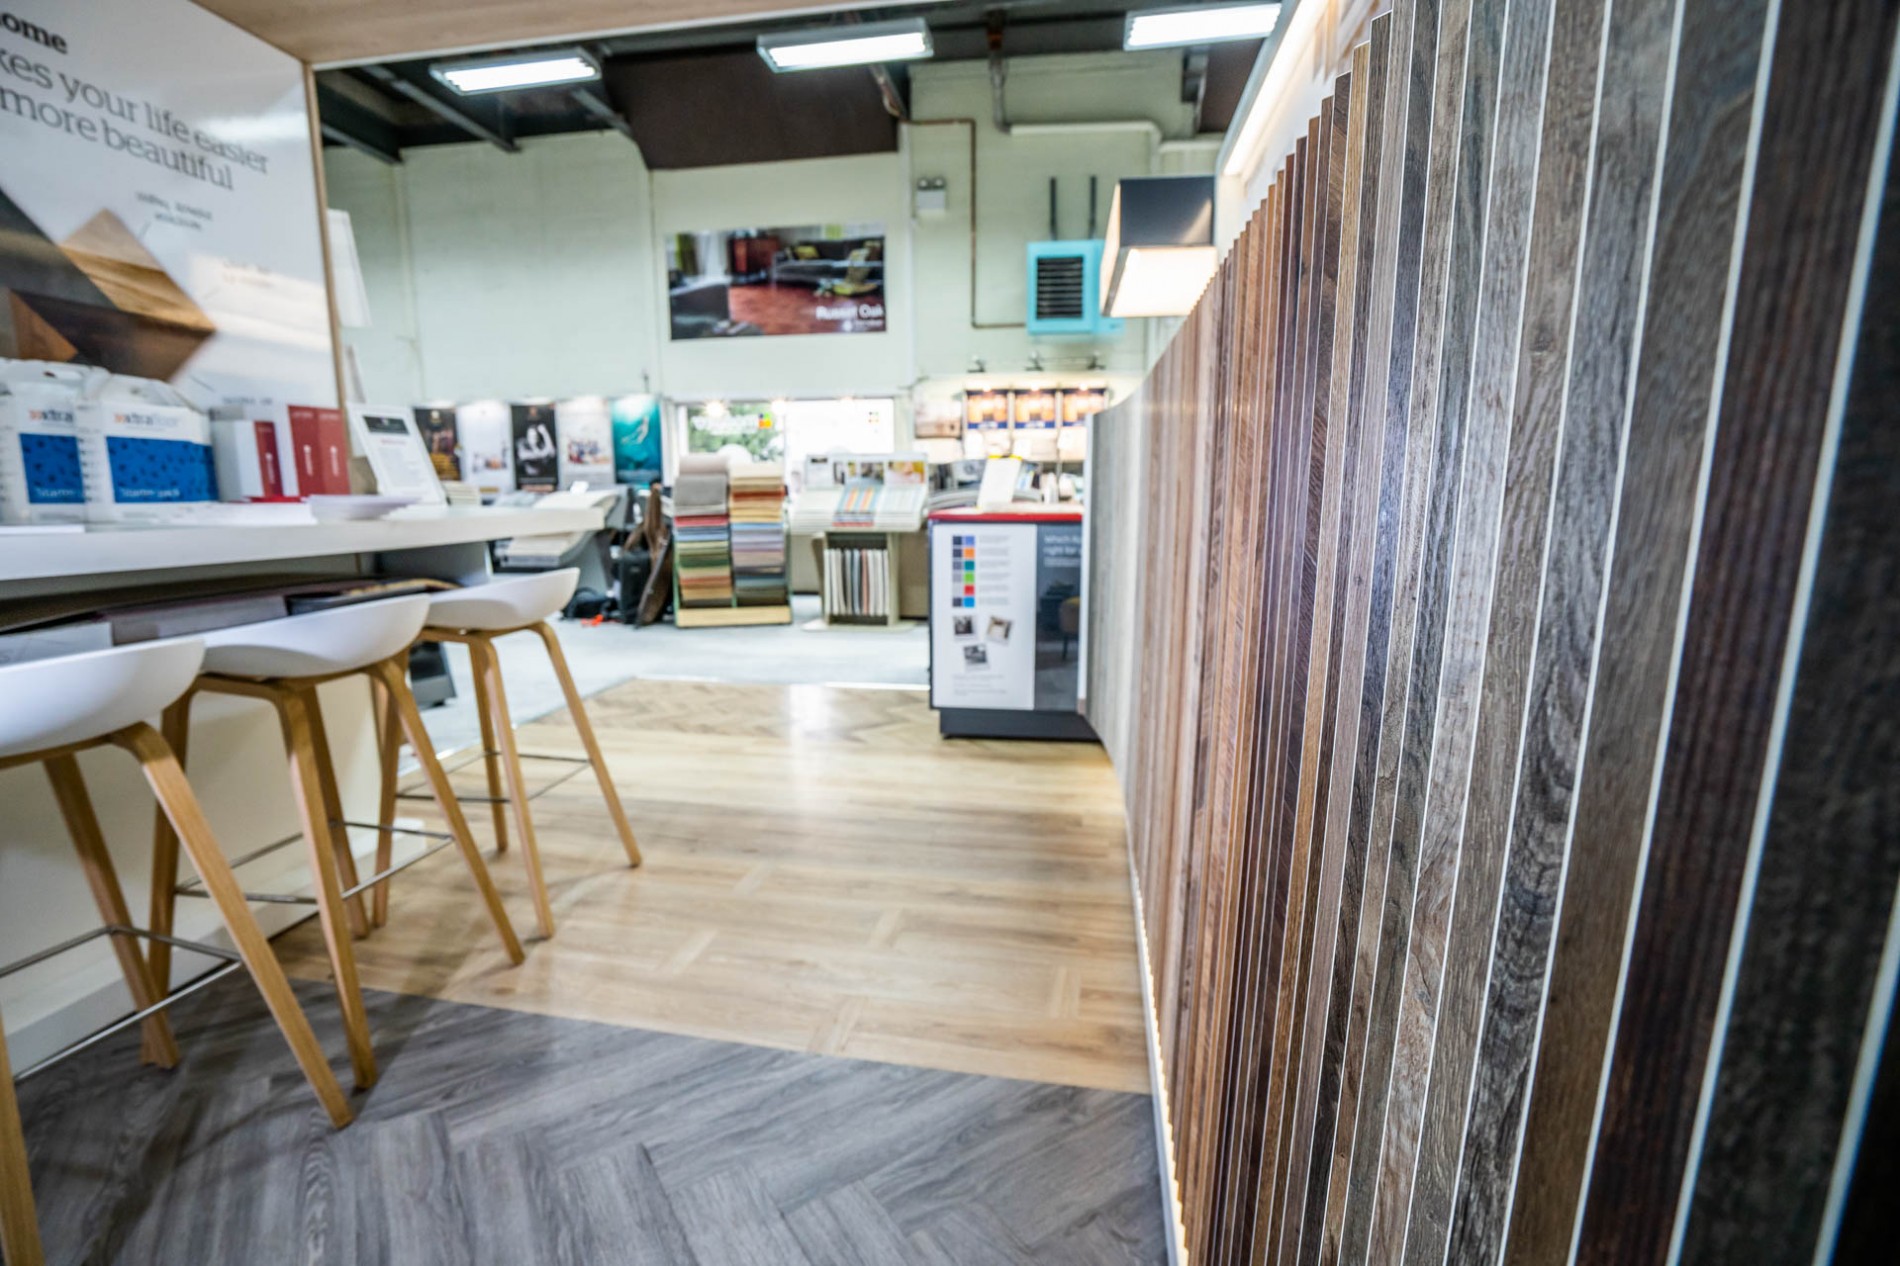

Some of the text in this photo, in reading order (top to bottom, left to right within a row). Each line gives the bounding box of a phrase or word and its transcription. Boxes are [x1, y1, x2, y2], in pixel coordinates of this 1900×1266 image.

[0, 12, 68, 55] ome
[0, 85, 234, 190] more beautiful
[58, 71, 138, 123] your
[143, 101, 191, 144] life
[194, 131, 268, 174] easier
